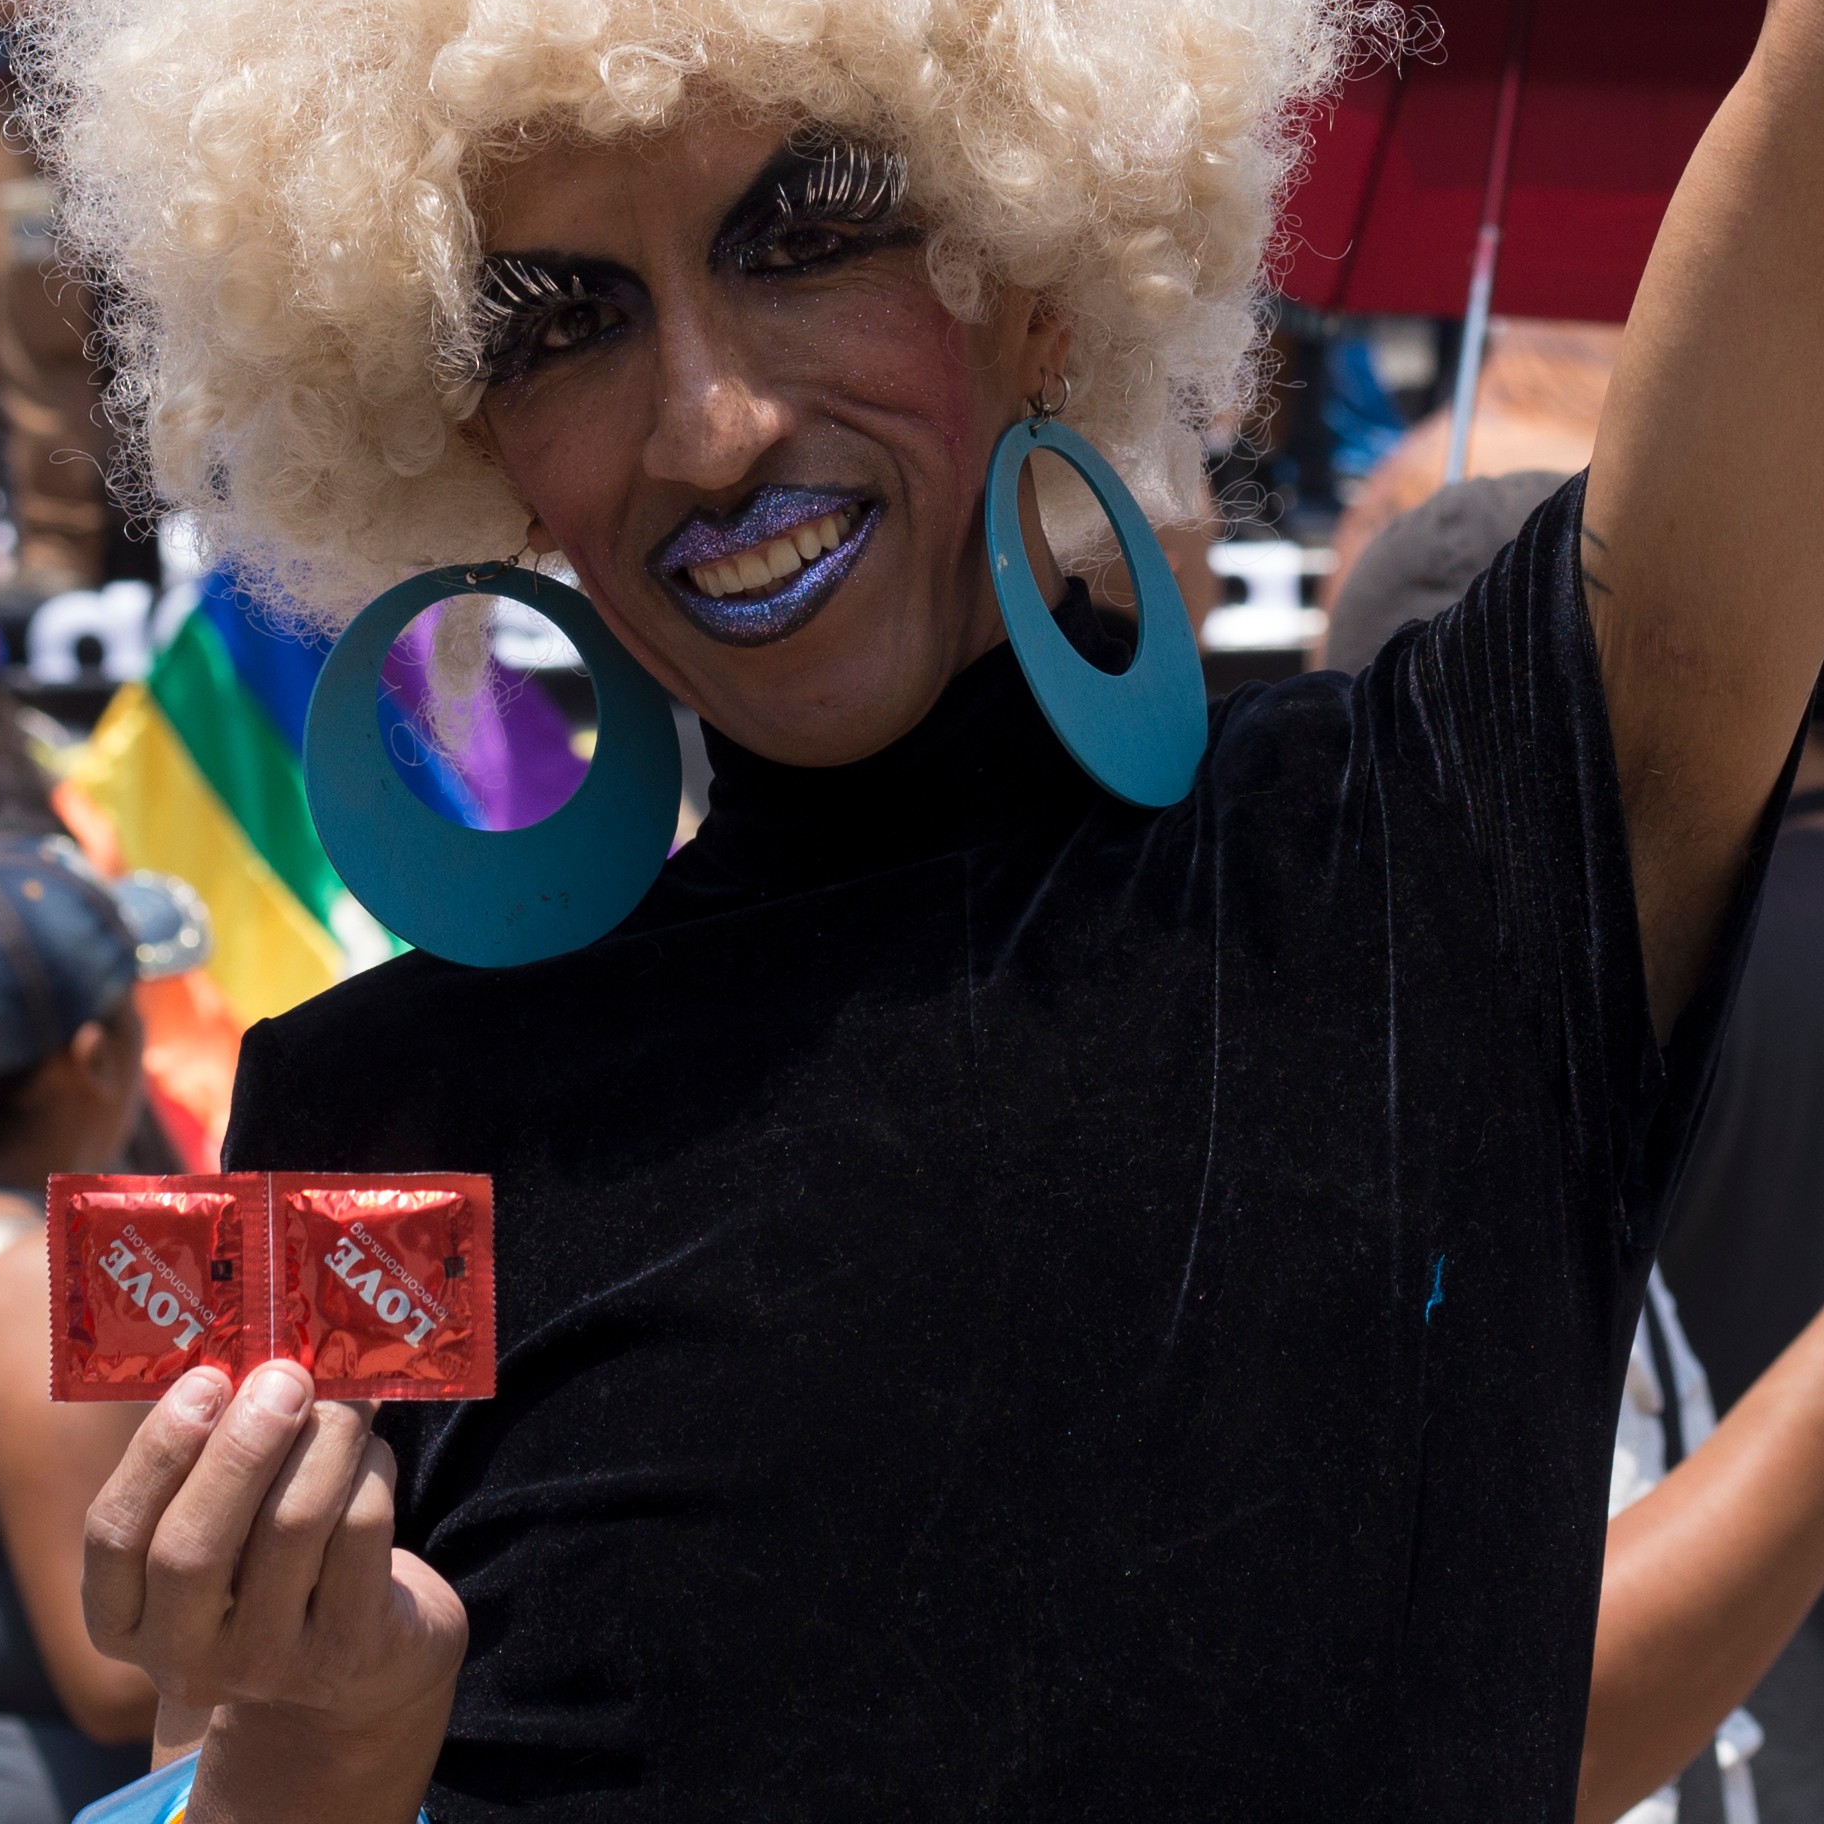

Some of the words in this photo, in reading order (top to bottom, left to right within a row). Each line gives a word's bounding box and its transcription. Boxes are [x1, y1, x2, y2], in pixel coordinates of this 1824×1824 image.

[98, 1239, 205, 1351] LOVE
[122, 1224, 216, 1326] lovecondoms.org
[324, 1236, 436, 1349] LOVE
[349, 1221, 449, 1323] lovecondoms.org
